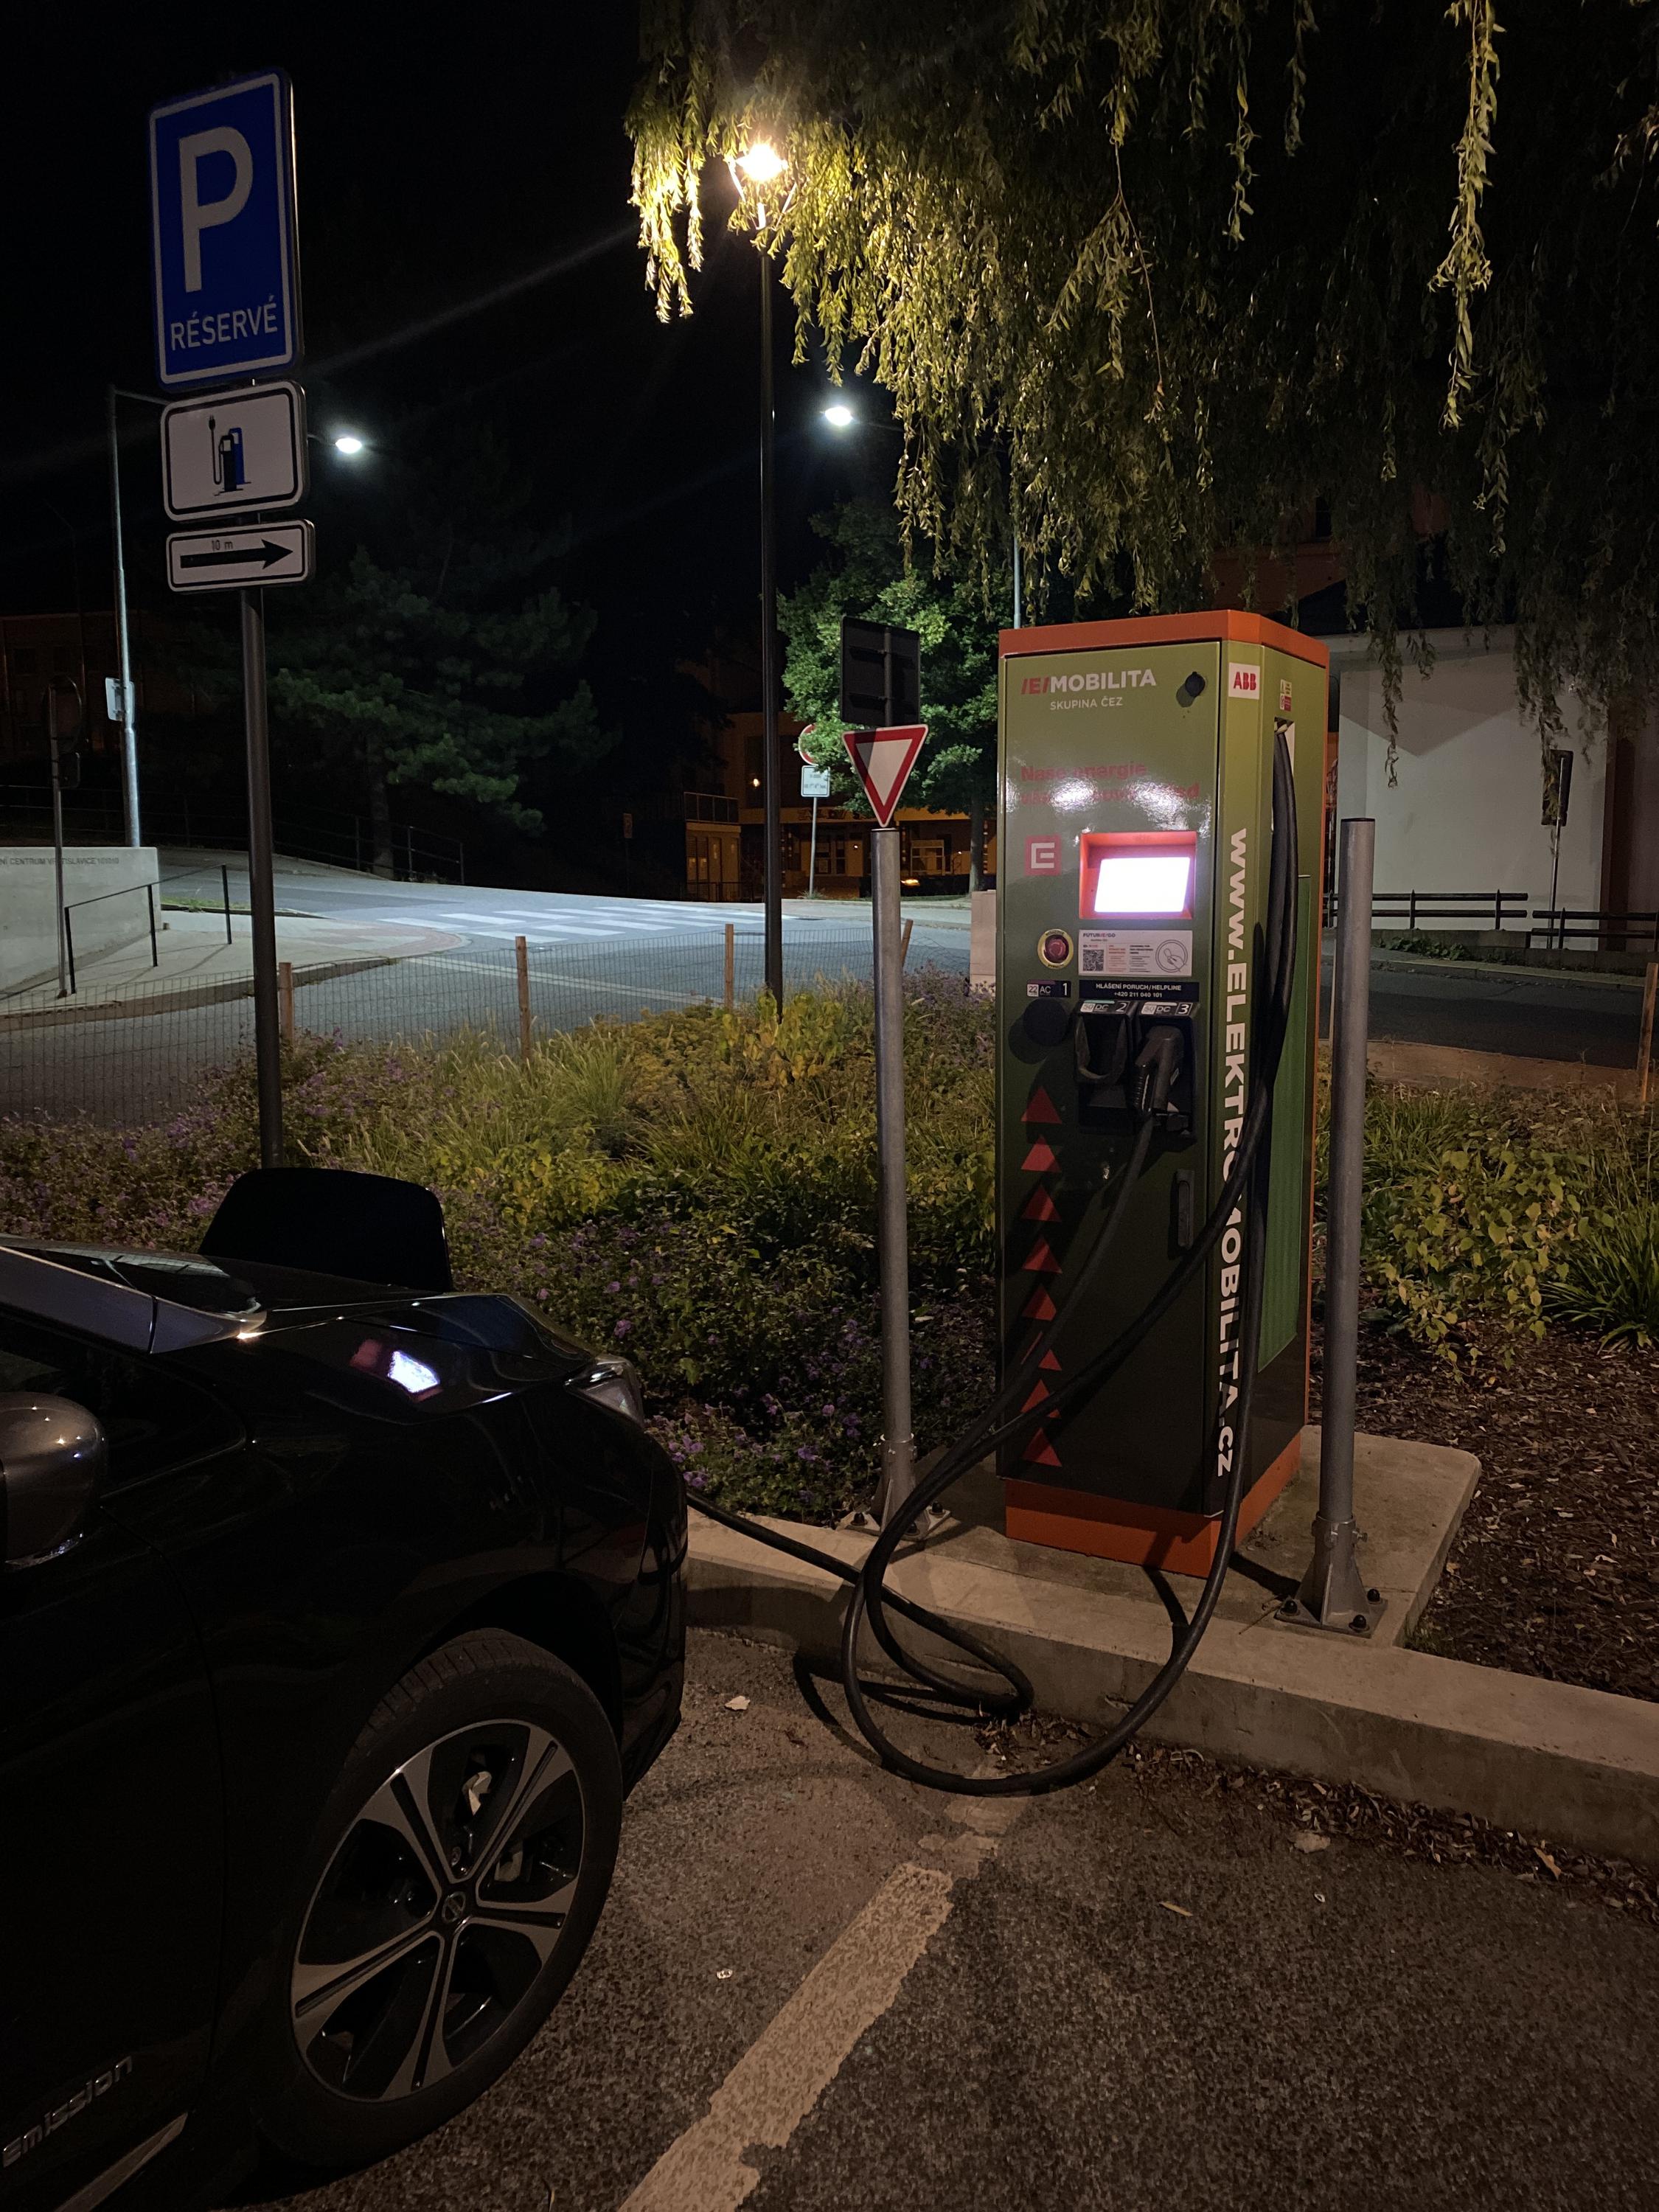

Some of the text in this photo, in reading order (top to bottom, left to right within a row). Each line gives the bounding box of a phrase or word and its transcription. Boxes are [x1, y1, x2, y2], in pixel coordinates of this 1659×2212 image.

[178, 126, 254, 293] P
[170, 294, 278, 351] RÉSERVÉ
[212, 540, 233, 552] 10 m
[1233, 671, 1257, 691] ABB
[1049, 695, 1124, 711] SKUPINA ČEZ
[46, 857, 97, 865] VRTISLAVICE
[1029, 983, 1068, 996] 22 AC 1
[1115, 1002, 1127, 1012] 2
[1178, 1004, 1190, 1015] 3
